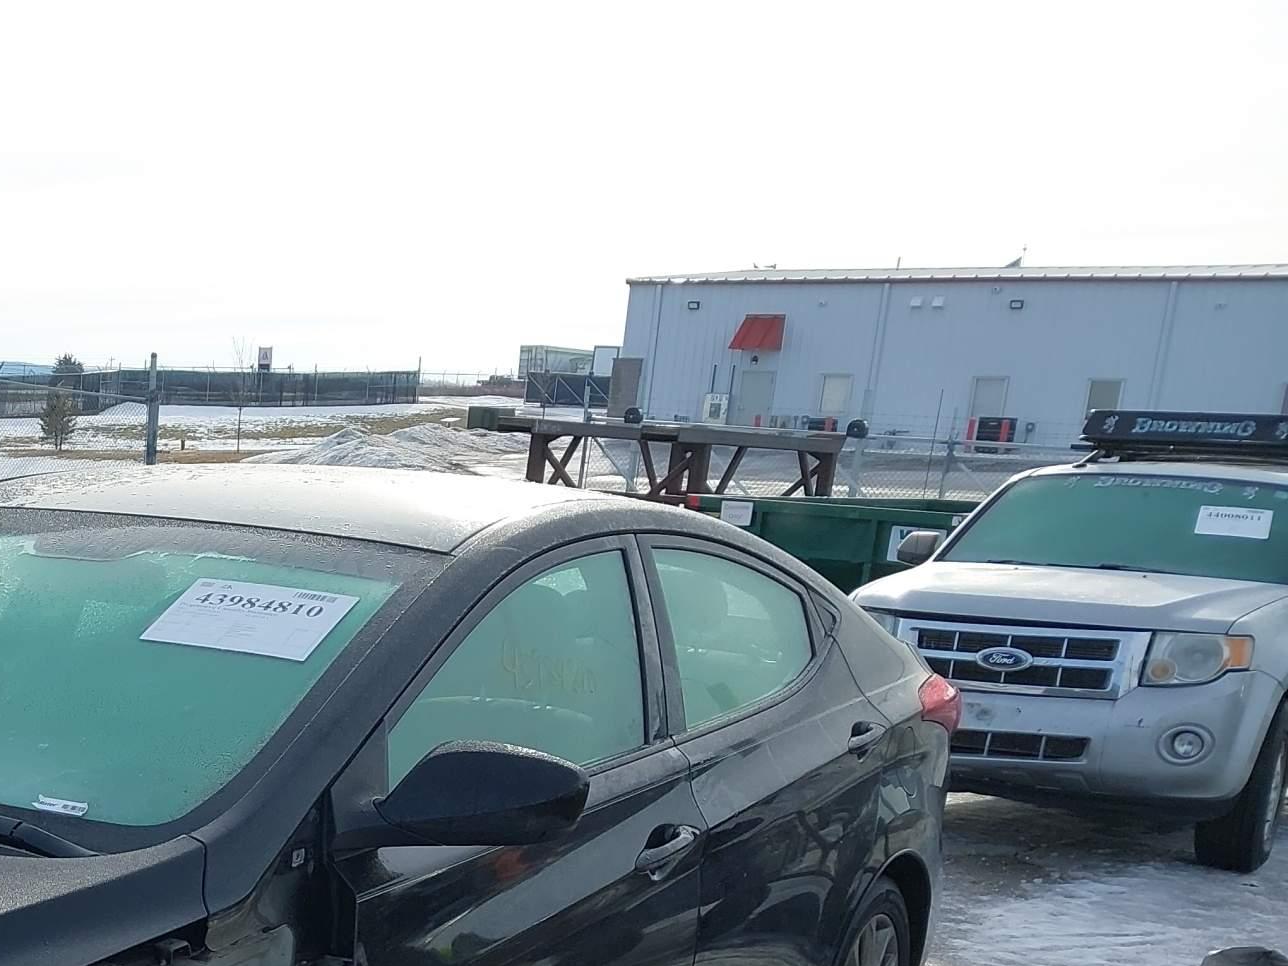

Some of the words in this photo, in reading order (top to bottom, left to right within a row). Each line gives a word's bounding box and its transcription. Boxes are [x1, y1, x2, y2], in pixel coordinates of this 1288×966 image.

[1132, 417, 1256, 436] BROWNING
[195, 592, 324, 618] 43984810
[989, 652, 1017, 665] Ford
